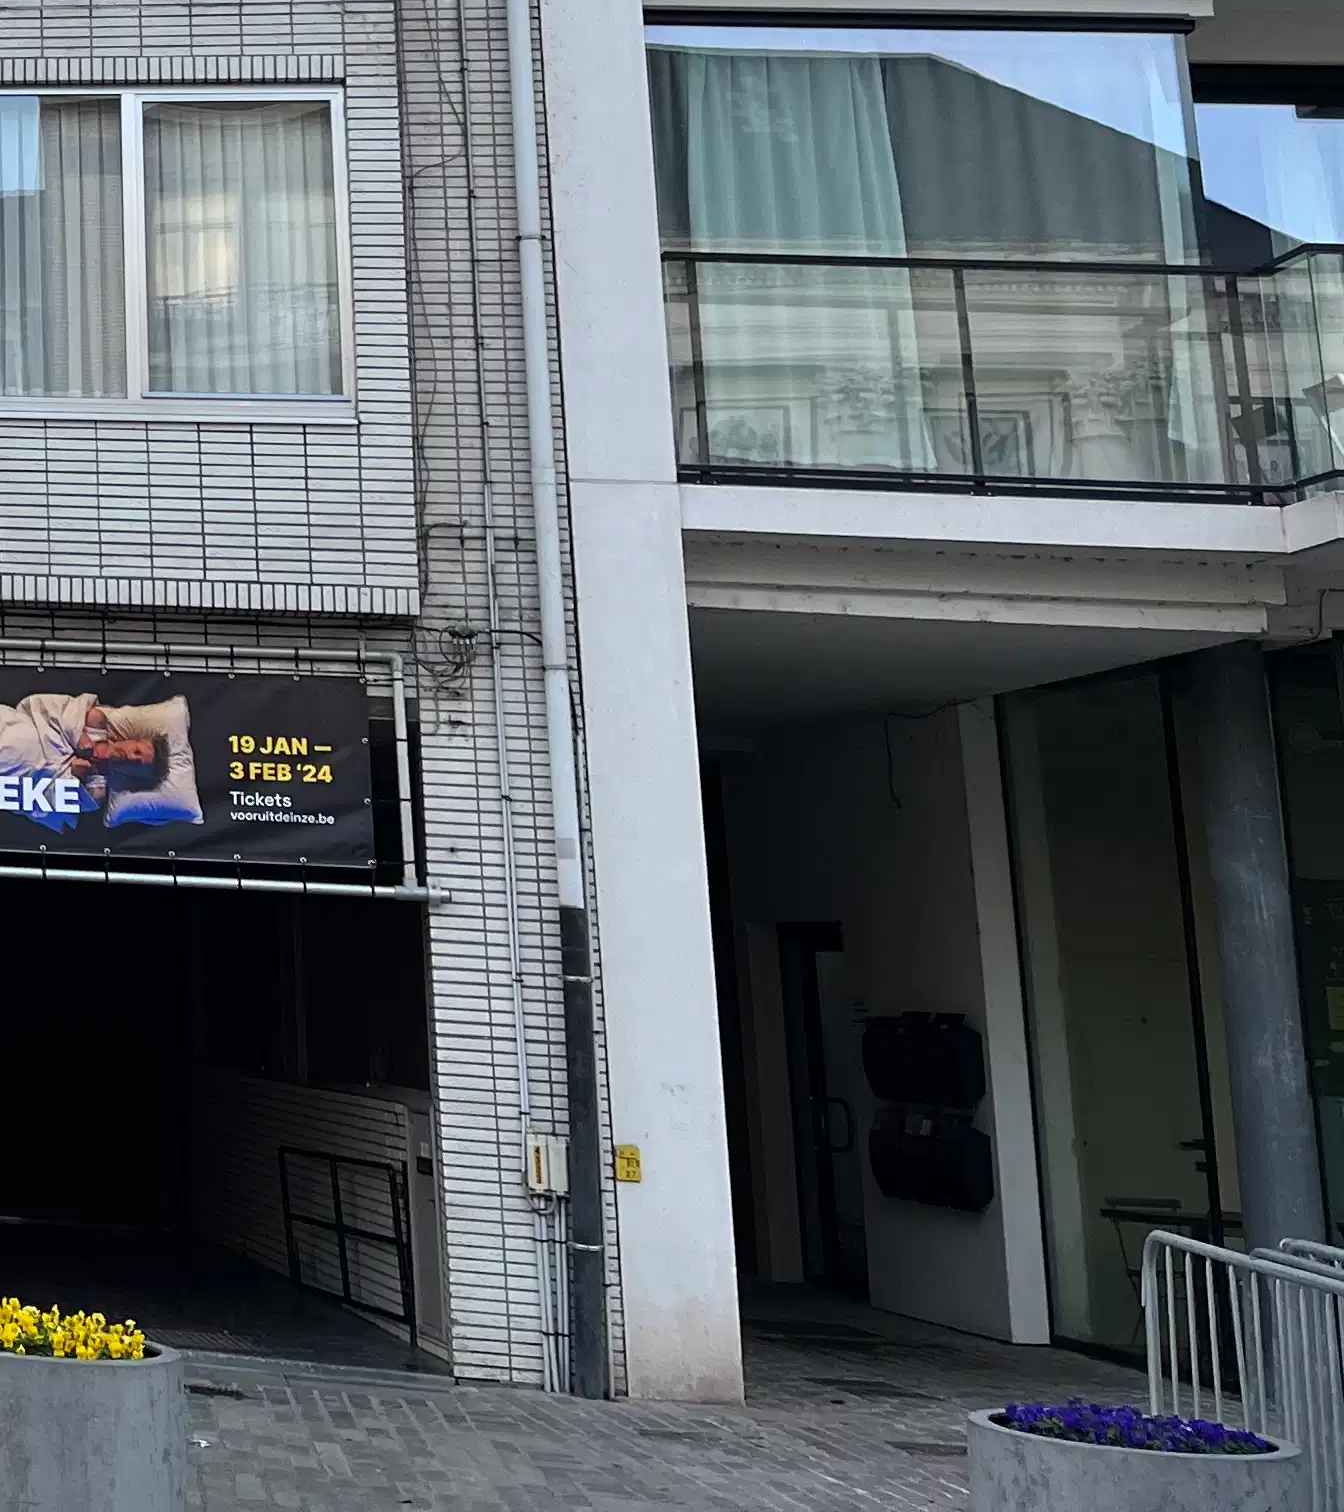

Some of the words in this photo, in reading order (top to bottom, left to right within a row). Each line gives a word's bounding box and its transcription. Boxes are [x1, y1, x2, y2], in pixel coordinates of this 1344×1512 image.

[228, 735, 255, 754] 19
[259, 736, 308, 756] JAN
[229, 761, 245, 780] 3
[248, 762, 292, 782] FEB
[229, 791, 292, 808] Tickets
[230, 810, 335, 825] vooruitdeinze.be
